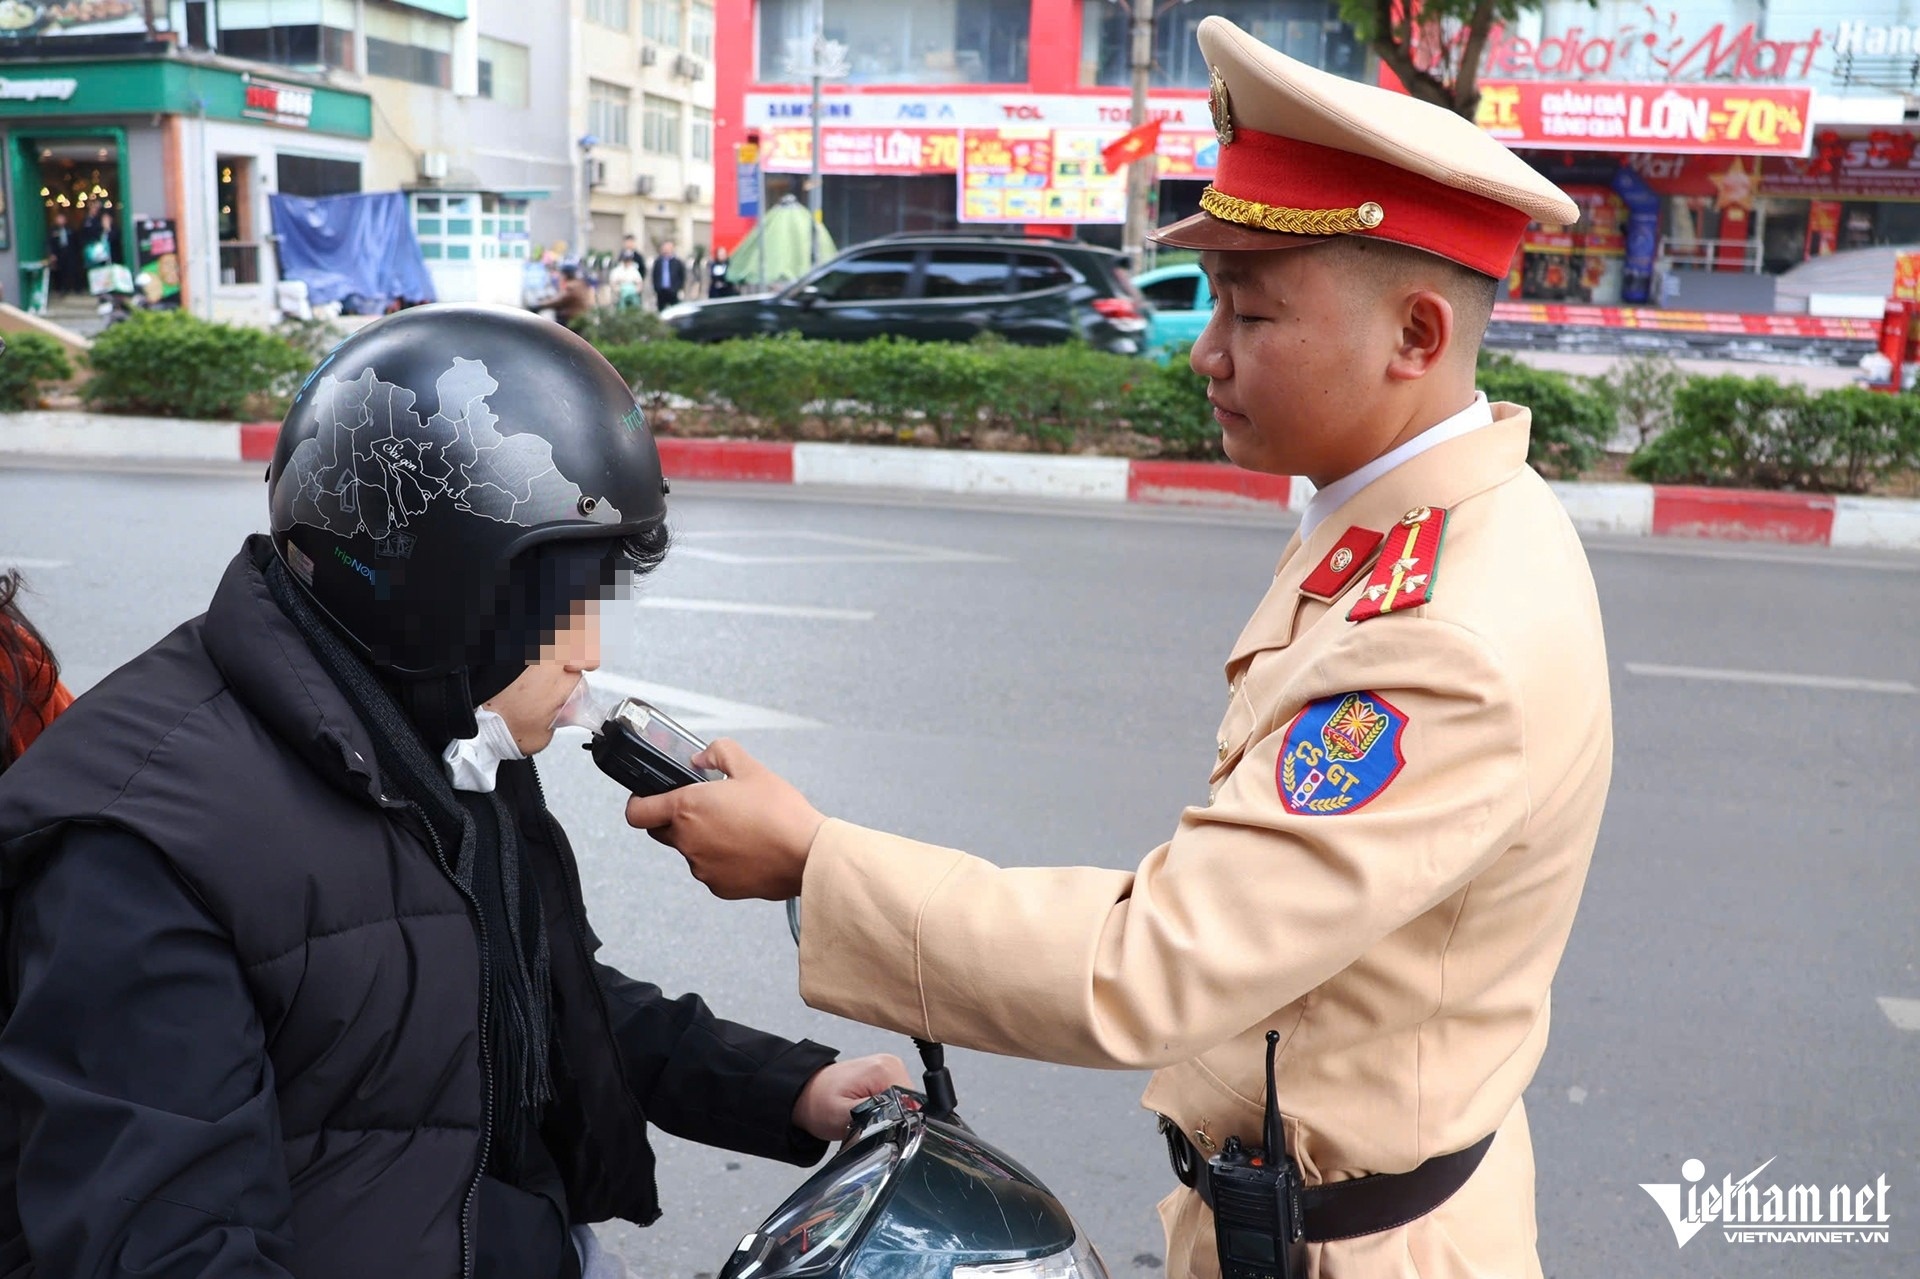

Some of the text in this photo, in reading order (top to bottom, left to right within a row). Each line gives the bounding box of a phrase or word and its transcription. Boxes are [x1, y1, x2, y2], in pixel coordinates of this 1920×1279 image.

[1668, 22, 1822, 77] Mart
[897, 103, 957, 120] AQA
[1002, 105, 1044, 120] TCL
[1098, 107, 1185, 122] TOSIBA
[1332, 733, 1354, 751] CAND
